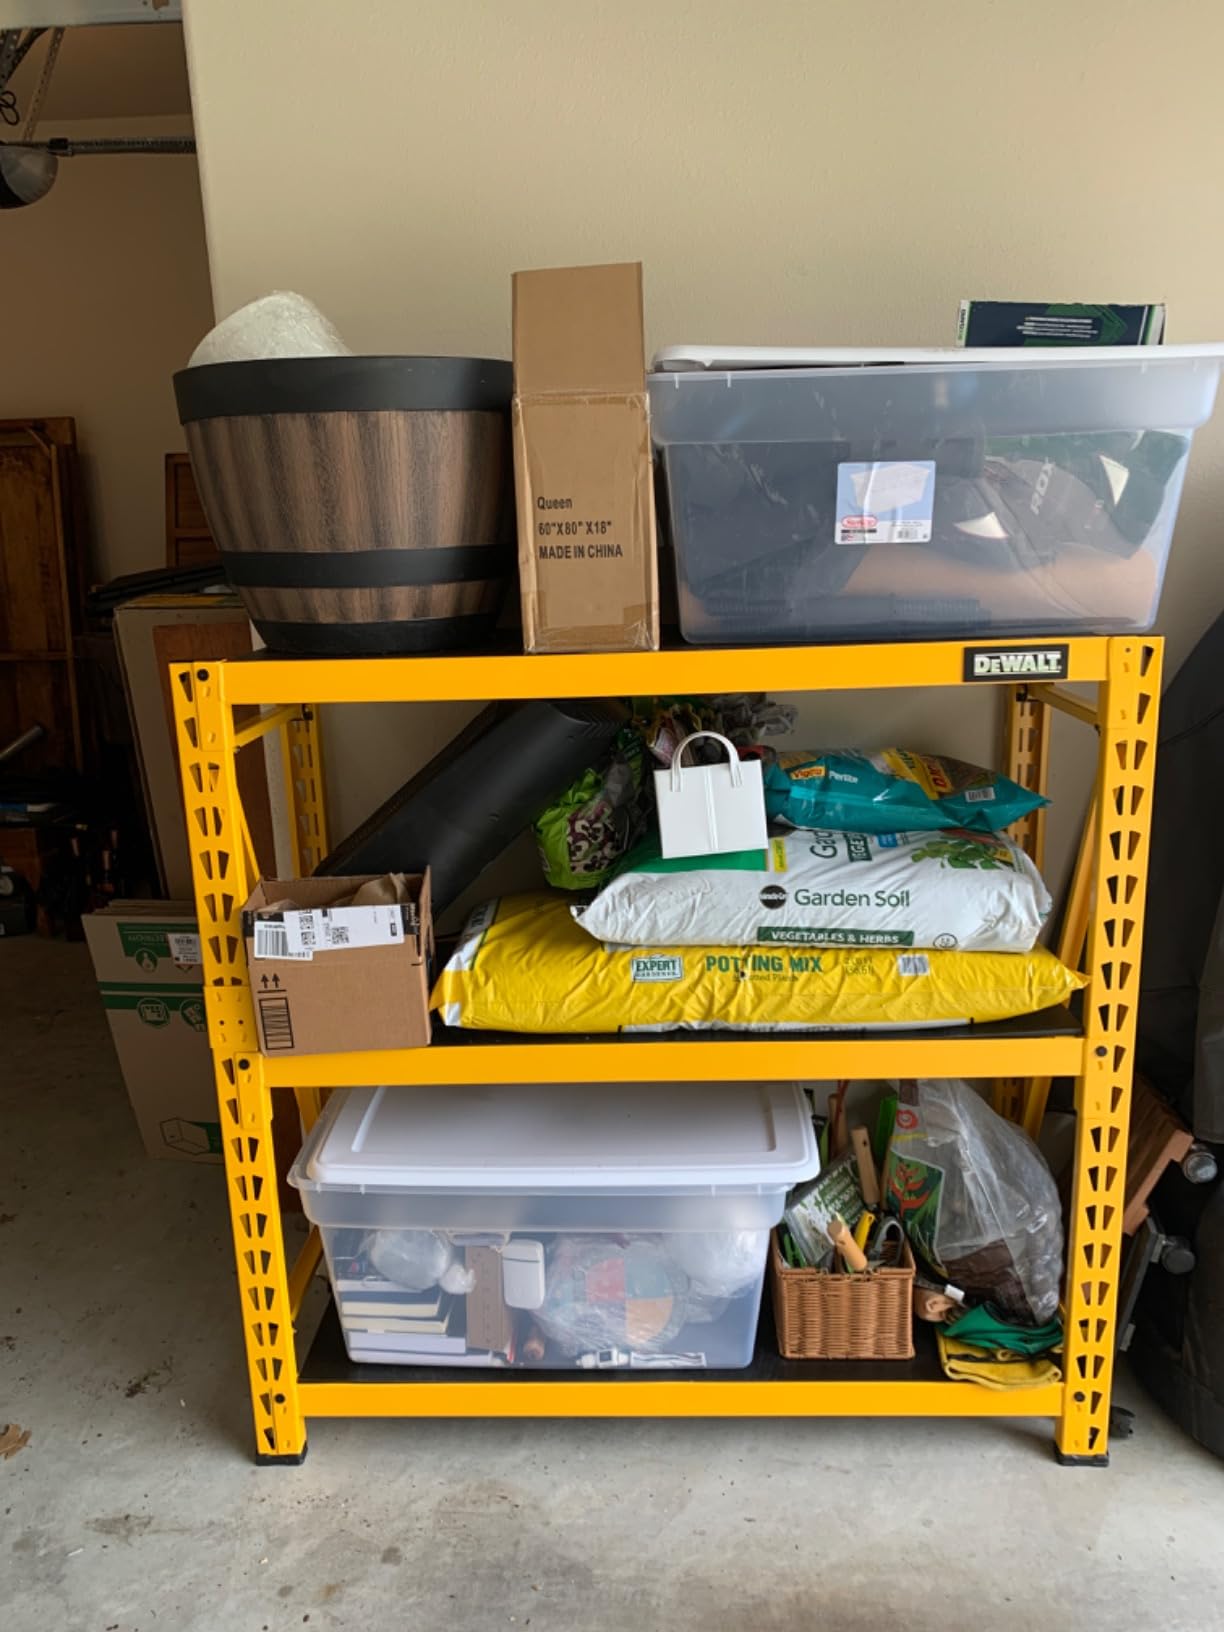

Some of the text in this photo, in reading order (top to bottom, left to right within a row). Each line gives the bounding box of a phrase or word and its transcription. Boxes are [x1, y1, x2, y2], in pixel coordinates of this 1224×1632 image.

[537, 496, 573, 510] Queen
[539, 544, 623, 559] MADE IN CHINA
[794, 888, 870, 907] Garden
[875, 889, 911, 908] Soil
[771, 930, 899, 945] VEGETABLES & HERBS
[635, 959, 676, 972] EXPERT
[706, 954, 783, 973] POTTING
[788, 955, 823, 973] MIX
